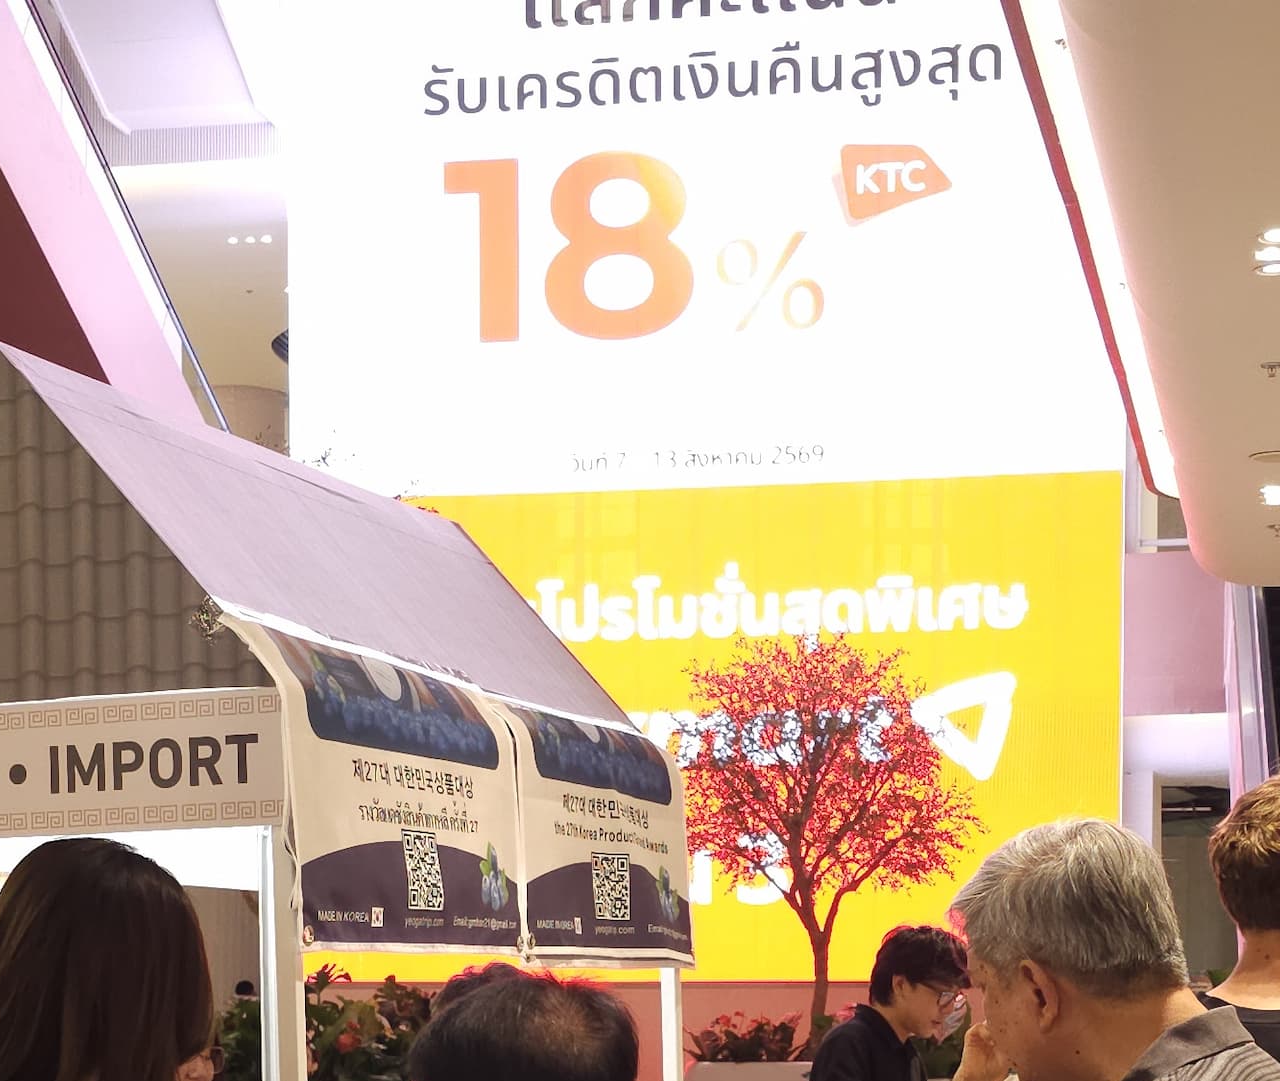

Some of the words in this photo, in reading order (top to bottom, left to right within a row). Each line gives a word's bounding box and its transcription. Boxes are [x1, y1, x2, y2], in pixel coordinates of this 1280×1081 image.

[423, 41, 1003, 117] รับเครดิตเงินคืนสูงสุด
[854, 160, 927, 194] KTC
[770, 444, 825, 466] 2569
[49, 733, 259, 795] IMPORT
[318, 910, 336, 922] MADE
[343, 911, 369, 924] KOREA
[536, 919, 554, 929] MADE
